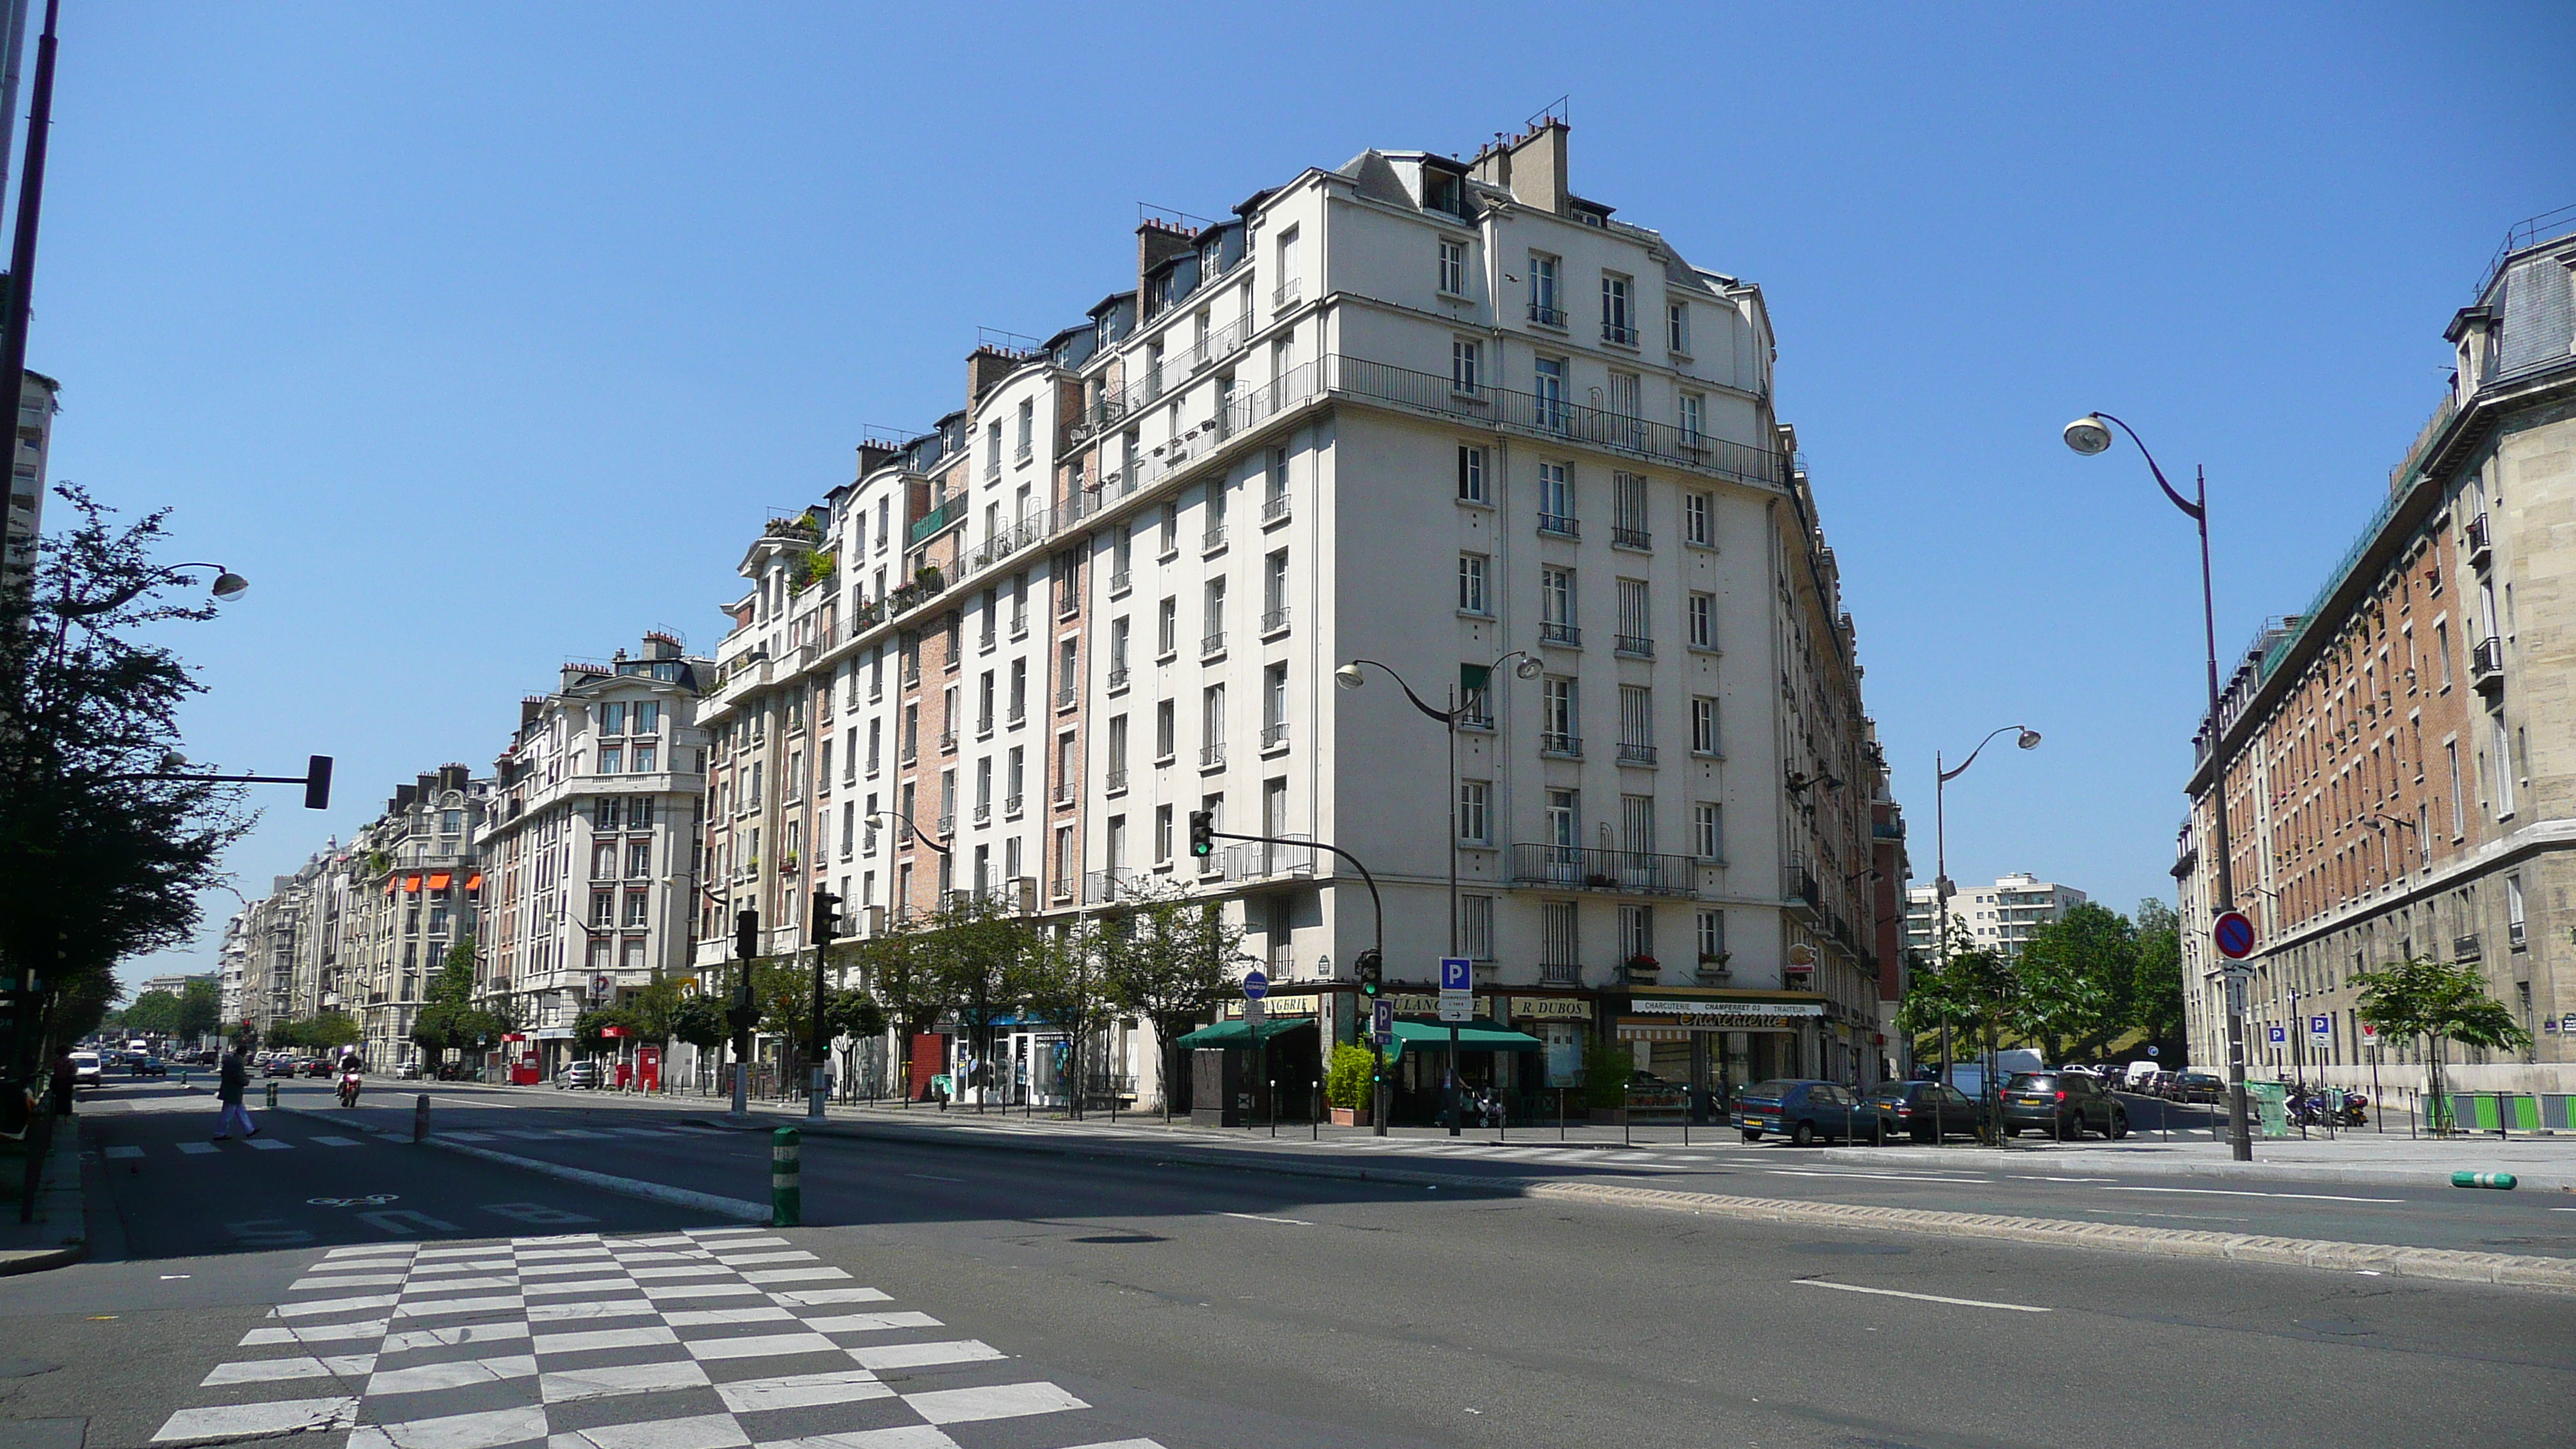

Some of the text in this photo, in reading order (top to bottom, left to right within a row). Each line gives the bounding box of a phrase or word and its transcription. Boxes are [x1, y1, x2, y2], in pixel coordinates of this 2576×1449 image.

[1449, 964, 1463, 985] P
[1538, 1002, 1582, 1014] DUBOS
[1645, 1002, 1691, 1011] CHARCUTERIE
[1704, 1003, 1750, 1012] CHAMPERRET
[1379, 1005, 1388, 1026] P
[2314, 1019, 2324, 1031] P
[2273, 1029, 2281, 1040] P
